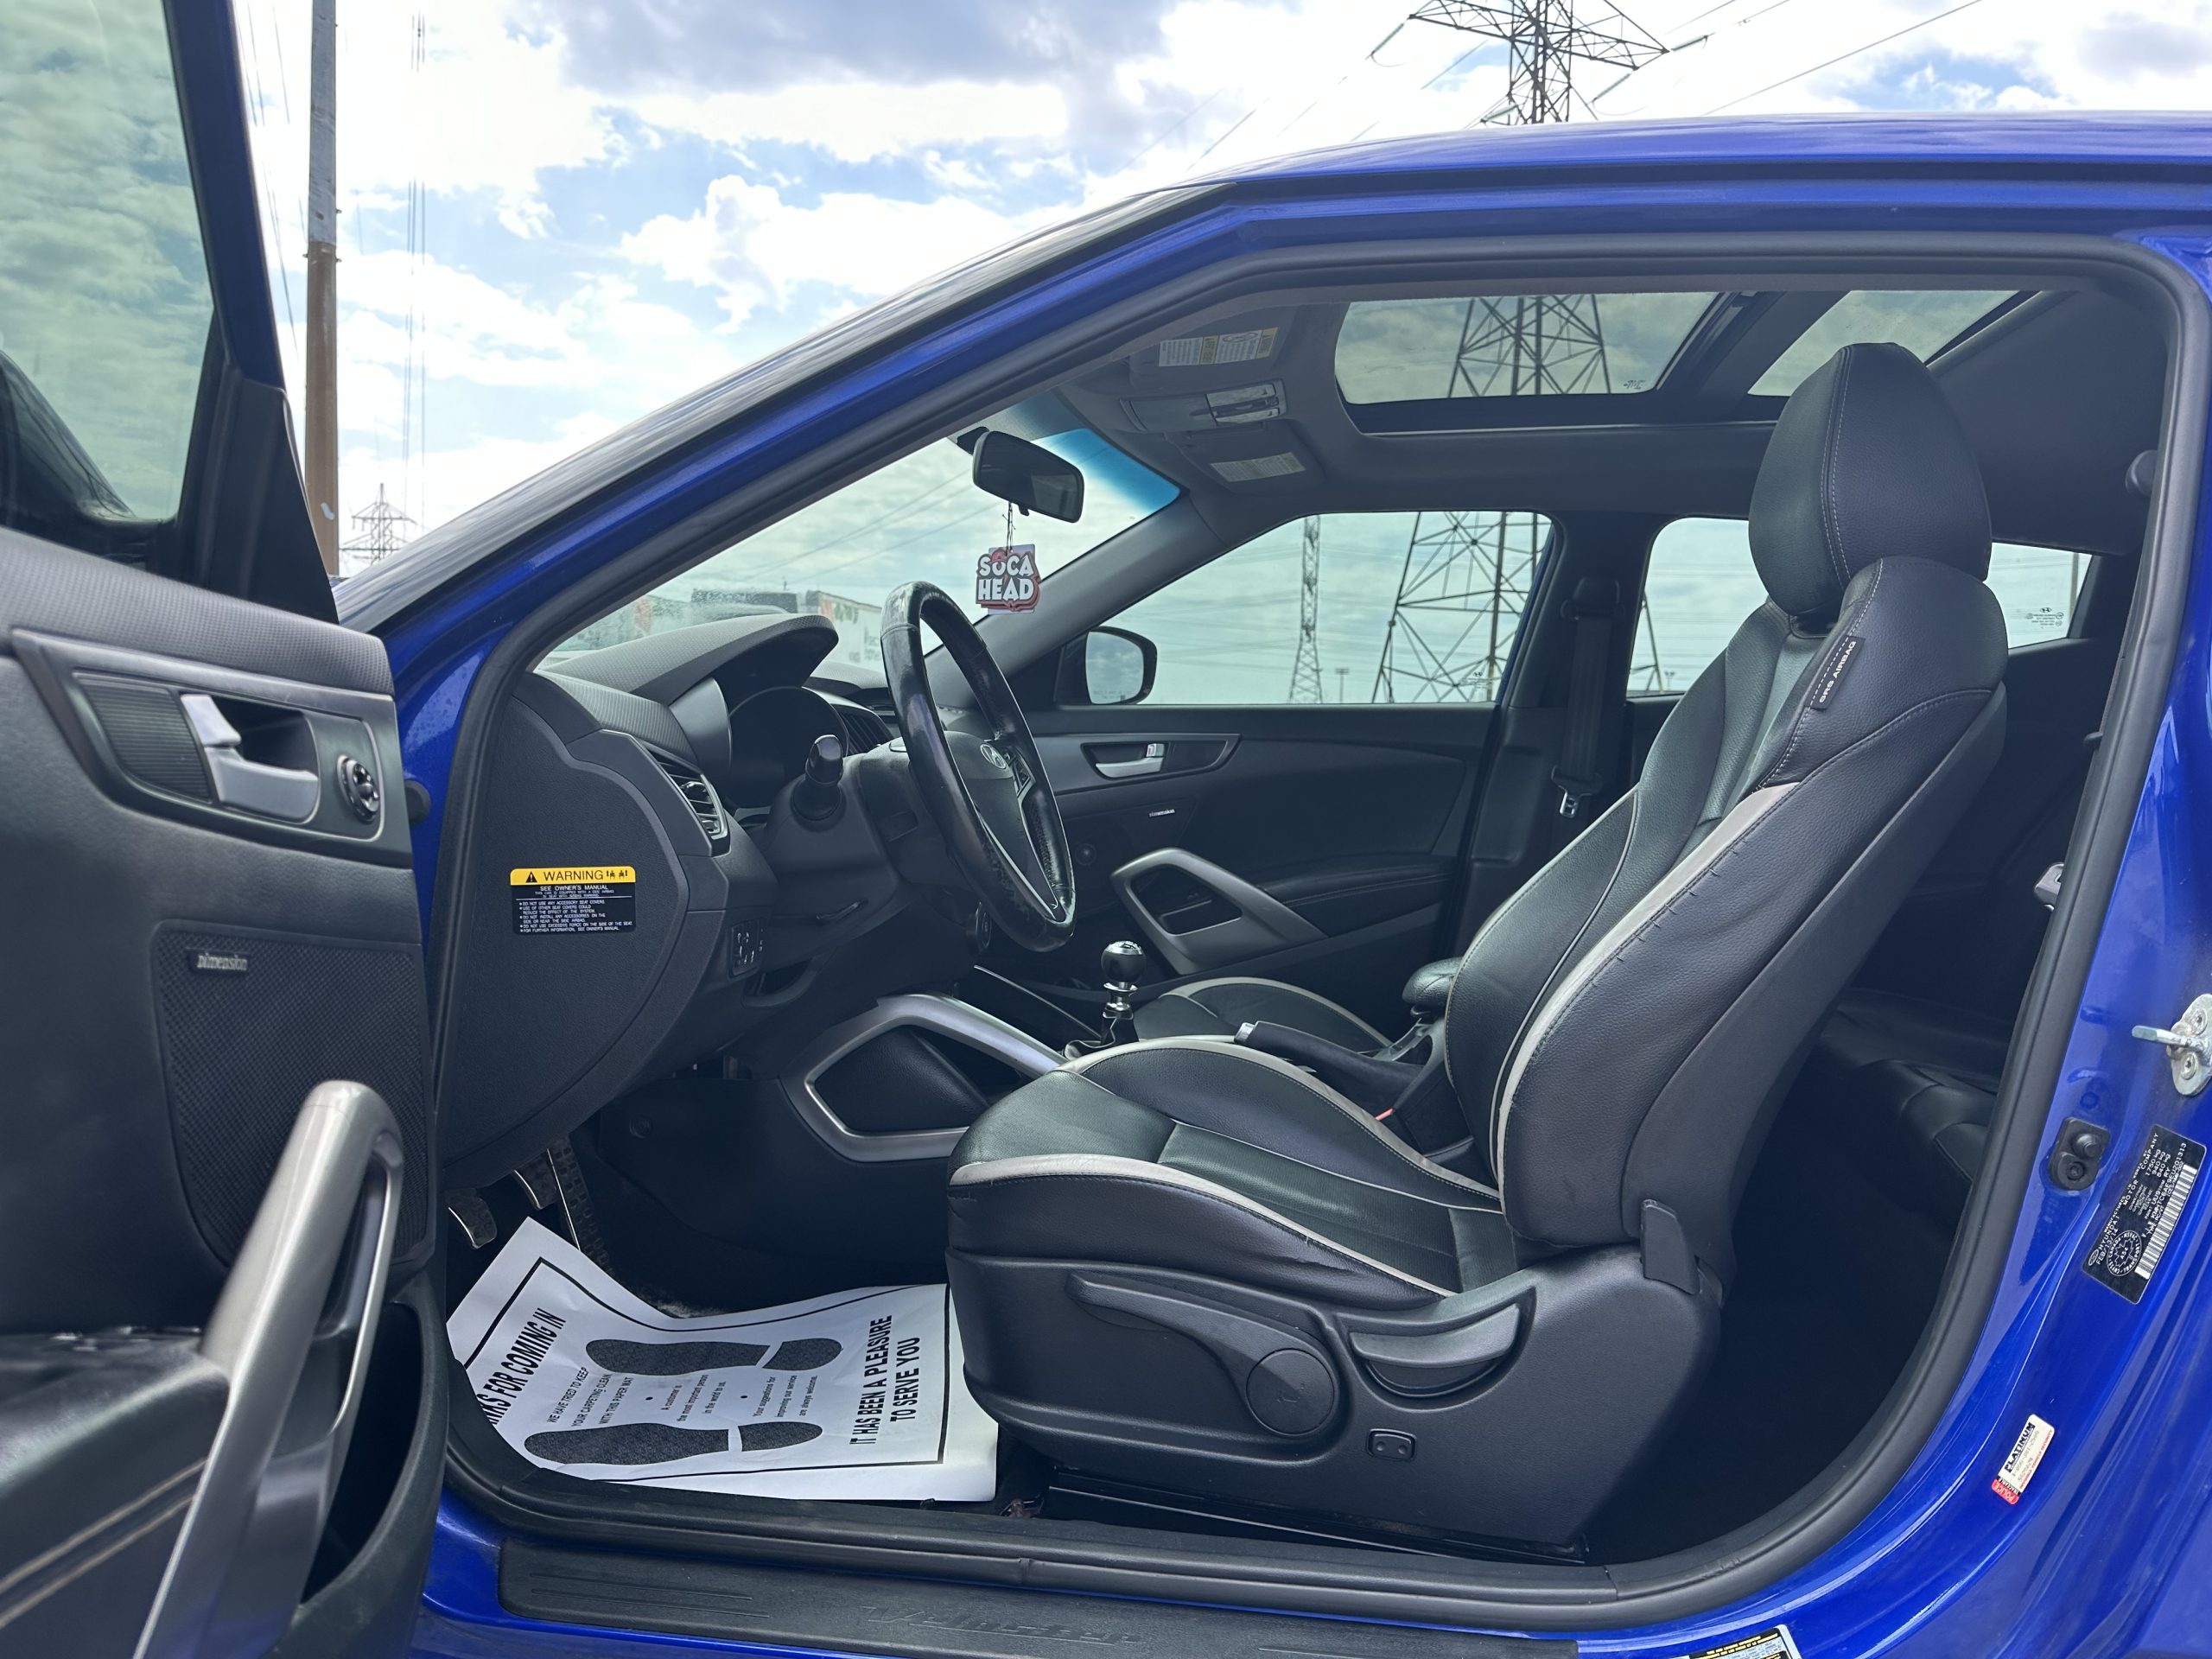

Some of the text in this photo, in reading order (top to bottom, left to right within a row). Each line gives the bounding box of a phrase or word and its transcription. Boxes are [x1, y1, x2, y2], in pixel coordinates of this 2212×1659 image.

[979, 554, 1034, 576] SOCA
[977, 578, 1034, 601] HEAD
[1833, 641, 1857, 678] AIRBAG
[543, 870, 603, 881] WARNING
[2150, 1160, 2161, 1175] 940
[2162, 1166, 2171, 1178] RY
[2097, 1132, 2159, 1250] HYUNDAI MOTOR COMPANY
[532, 1307, 566, 1330] IN
[501, 1321, 557, 1376] COMING
[864, 1315, 893, 1377] PLEASURE
[483, 1371, 529, 1399] FOR
[570, 1381, 583, 1389] TO
[575, 1366, 589, 1382] KEEP
[863, 1378, 887, 1388] A
[890, 1337, 920, 1422] TO SERVE YOU
[553, 1402, 569, 1415] HAVE
[857, 1390, 886, 1415] BEEN
[571, 1414, 588, 1427] YOUR
[852, 1417, 881, 1435] HAS
[2003, 1421, 2036, 1472] PLATINUM
[1993, 1481, 2016, 1502] POLICE
